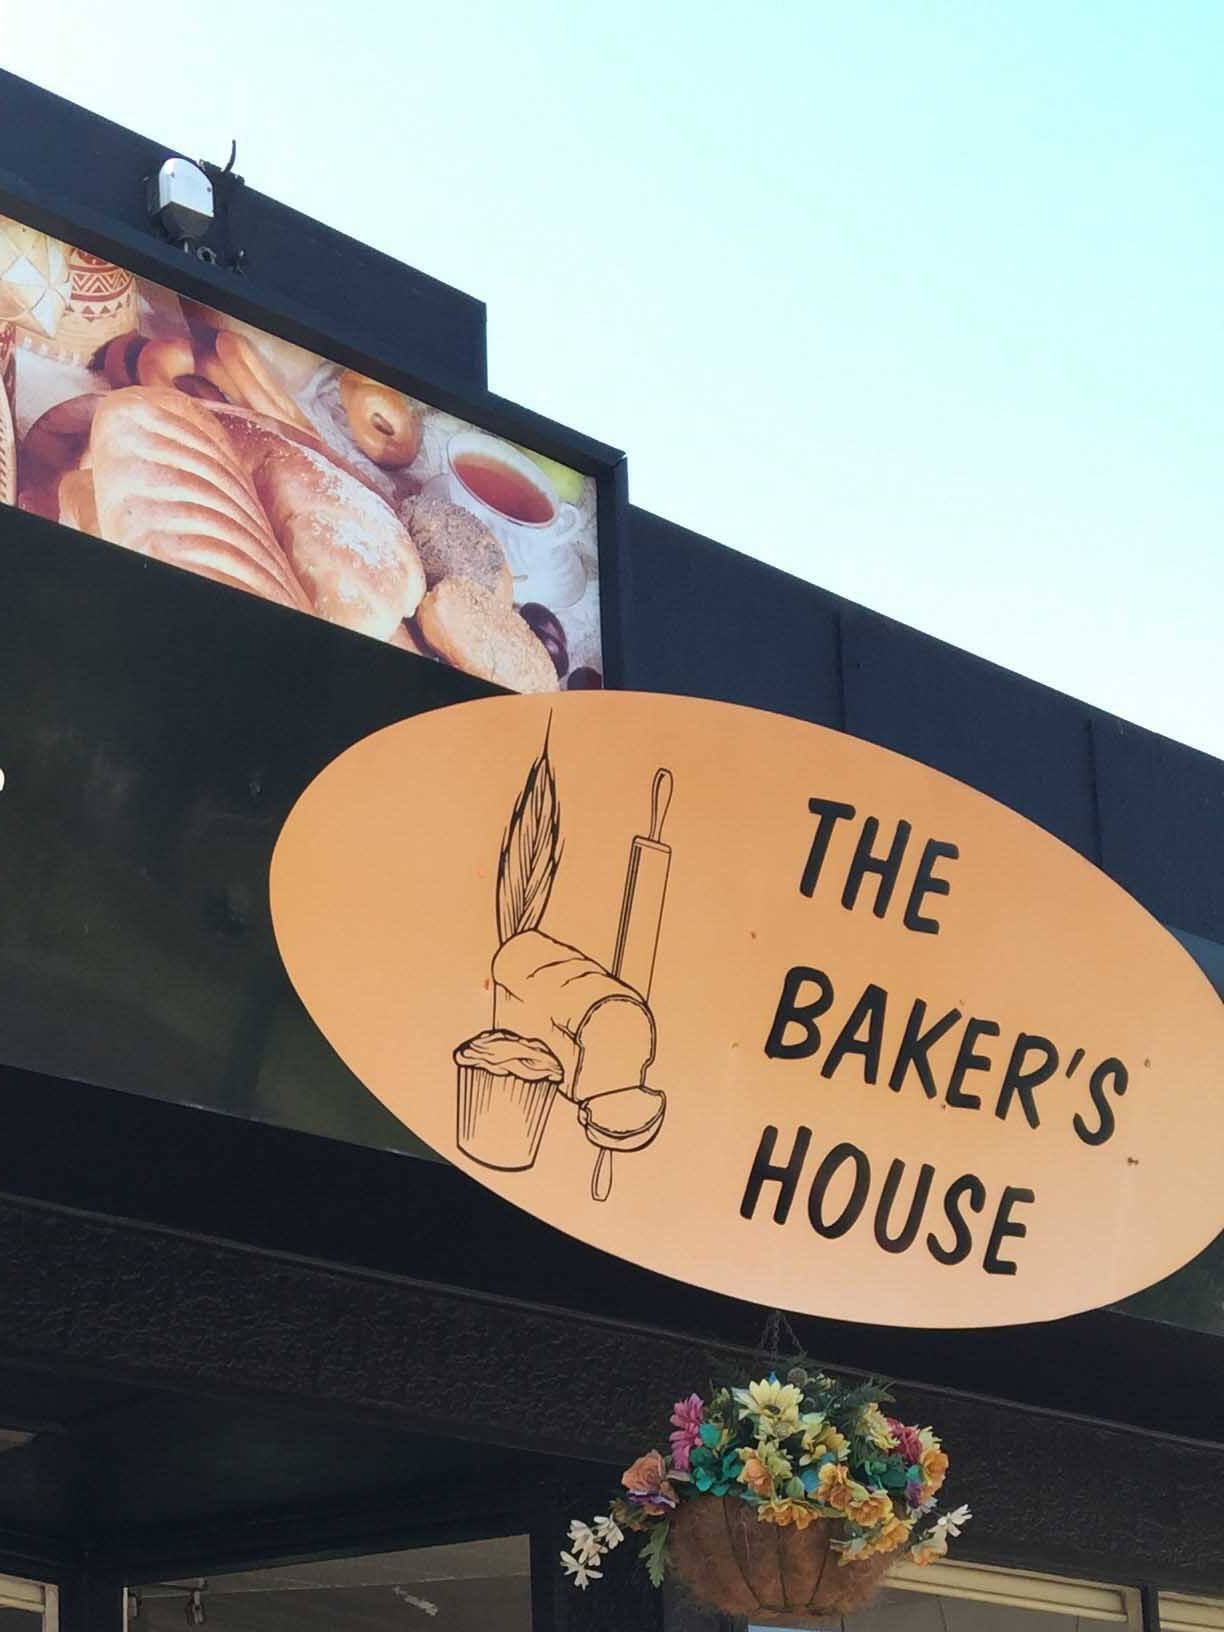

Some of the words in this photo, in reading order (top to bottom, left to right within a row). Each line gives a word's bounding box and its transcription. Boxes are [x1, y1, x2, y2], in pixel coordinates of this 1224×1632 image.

[798, 796, 960, 935] THE
[764, 965, 1130, 1147] BAKER'S
[739, 1124, 1036, 1276] HOUSE
